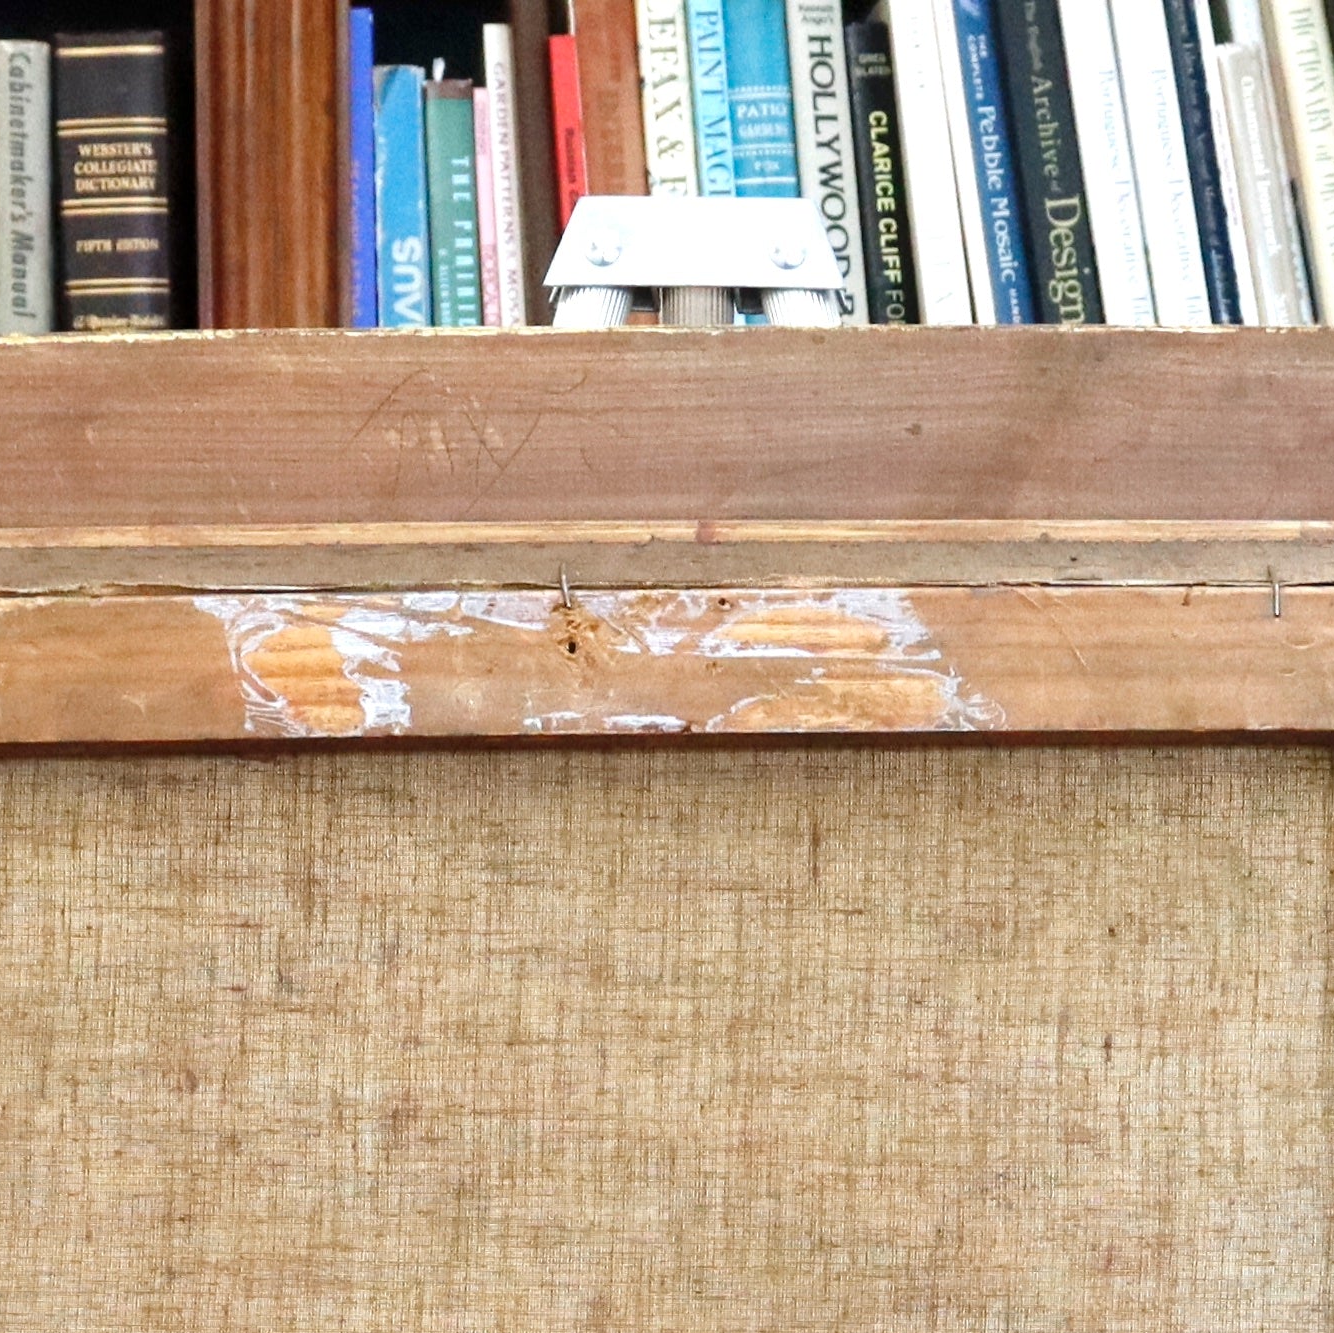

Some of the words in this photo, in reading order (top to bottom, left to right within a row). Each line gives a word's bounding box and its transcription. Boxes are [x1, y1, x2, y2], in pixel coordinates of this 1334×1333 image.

[696, 11, 725, 102] PAINT
[1289, 6, 1332, 132] DICTIONARY
[7, 51, 33, 222] Cabinetmaker's
[493, 62, 509, 147] GARDEN
[657, 136, 684, 158] &
[737, 103, 788, 119] PATIO
[1030, 75, 1062, 177] Archive
[74, 159, 158, 174] COLLEGIATE
[76, 177, 156, 193] DICTIONARY
[78, 143, 154, 156] WEBSTER'S
[451, 156, 472, 201] THE
[807, 33, 851, 279] HOLLYWOOD
[868, 111, 896, 212] CLARICE
[977, 106, 1005, 191] Pebble
[498, 150, 515, 244] PATTERNS
[990, 197, 1020, 283] Mosaic
[10, 229, 38, 319] Manual
[878, 217, 902, 284] CLIFF
[1045, 196, 1091, 324] Design
